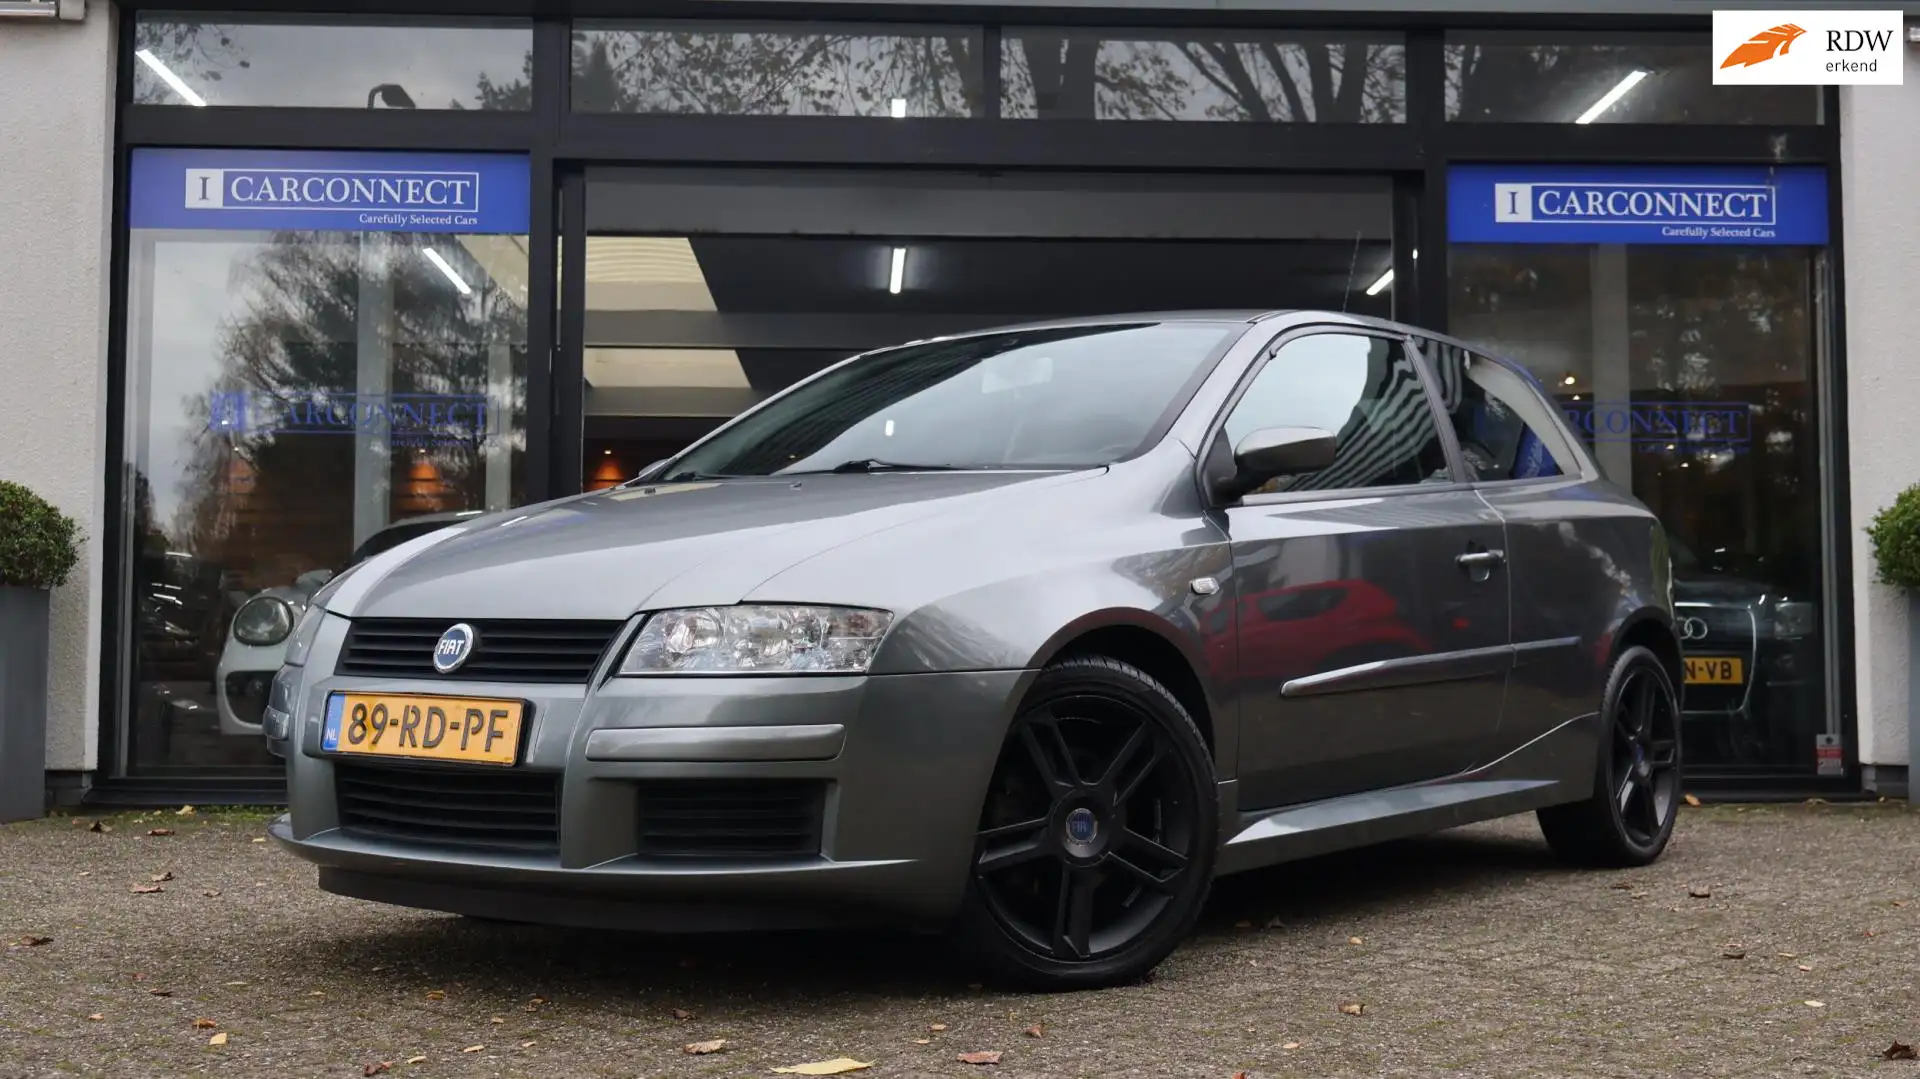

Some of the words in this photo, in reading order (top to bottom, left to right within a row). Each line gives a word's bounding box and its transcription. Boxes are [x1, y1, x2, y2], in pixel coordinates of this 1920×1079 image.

[198, 176, 210, 201] I
[231, 175, 471, 206] CARCONNECT
[1508, 191, 1519, 215] I
[1538, 190, 1768, 218] CARCONNECT
[359, 213, 407, 227] Carefully
[410, 214, 452, 225] Selected
[454, 215, 478, 225] Cars
[1662, 226, 1708, 239] Carefully
[1710, 226, 1750, 238] Selected
[1753, 228, 1776, 238] Cars
[1564, 409, 1745, 434] RCONNECT
[438, 638, 464, 655] FIAT
[1684, 660, 1732, 680] N-VB
[326, 727, 337, 741] NL
[347, 703, 509, 753] 89-RD-PF
